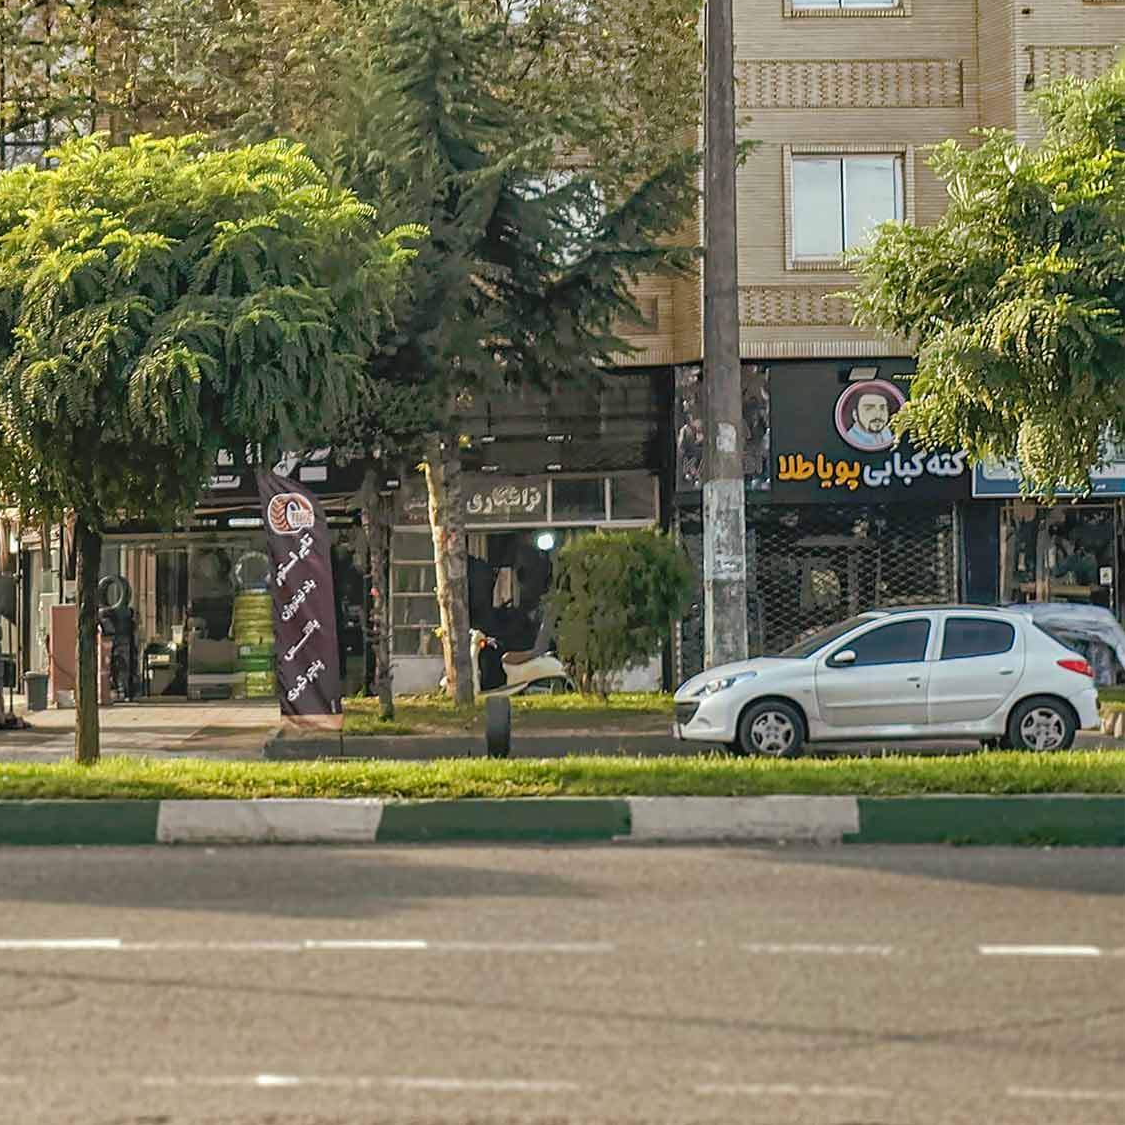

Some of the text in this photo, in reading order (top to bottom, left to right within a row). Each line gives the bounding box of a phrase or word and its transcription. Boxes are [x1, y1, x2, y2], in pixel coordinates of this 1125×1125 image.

[778, 453, 816, 481] طلا
[817, 454, 862, 491] پویا
[863, 450, 926, 487] کبابی
[926, 450, 968, 477] کته
